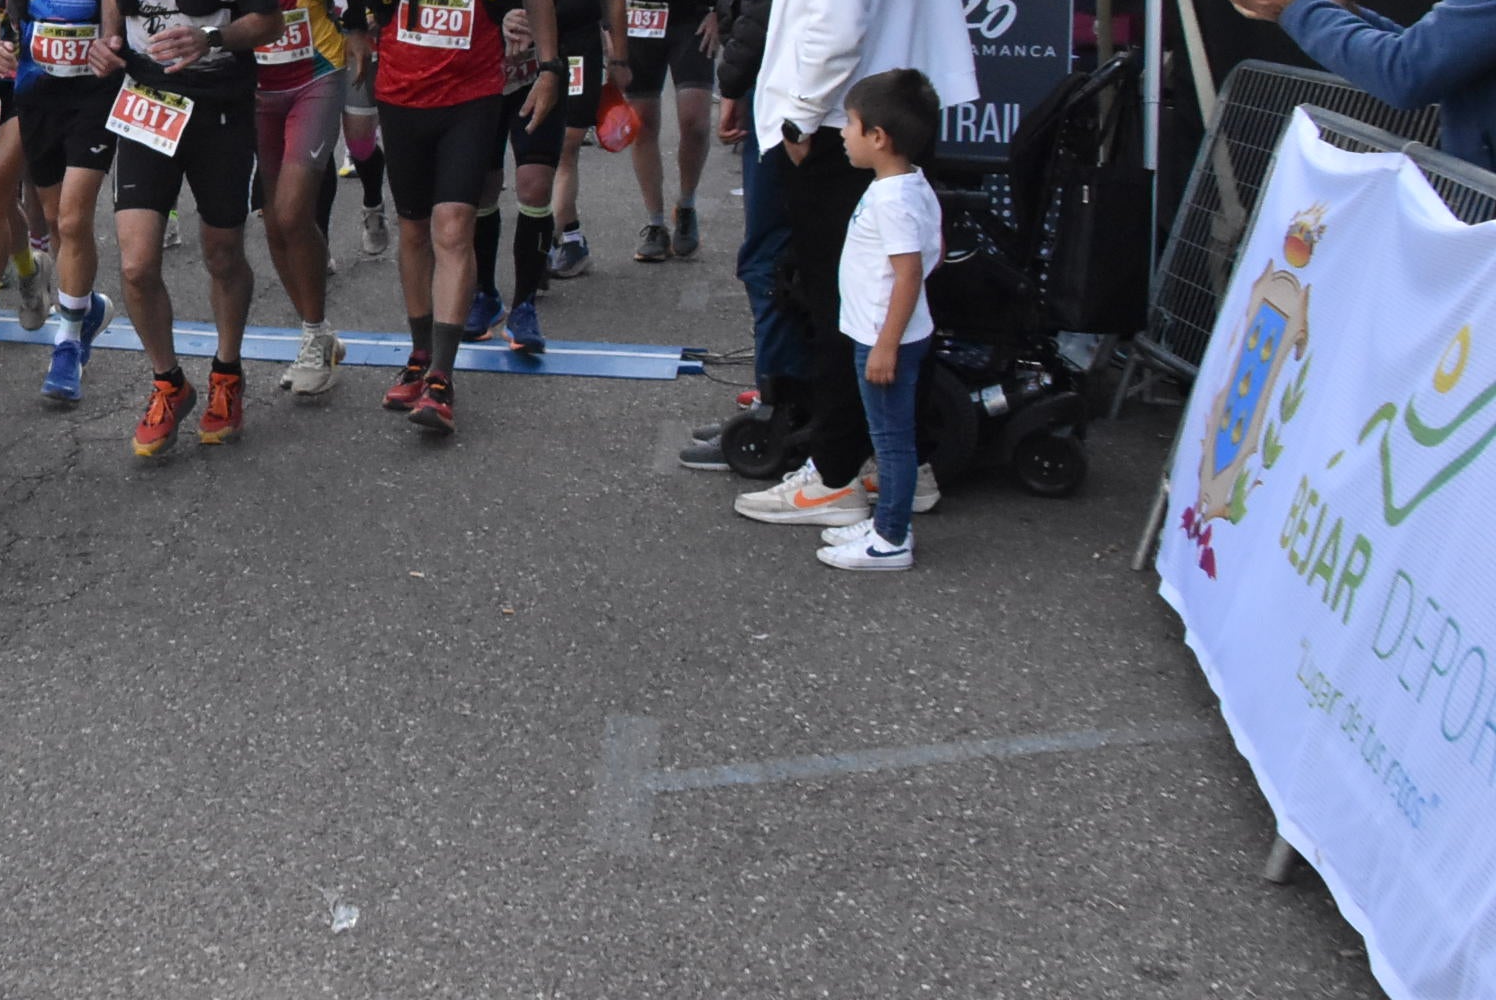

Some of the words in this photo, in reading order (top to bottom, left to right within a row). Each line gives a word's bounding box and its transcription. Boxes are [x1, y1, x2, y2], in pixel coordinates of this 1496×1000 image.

[420, 7, 464, 32] 020
[626, 10, 660, 26] 1031
[40, 38, 90, 61] 1037
[122, 94, 179, 132] 1017
